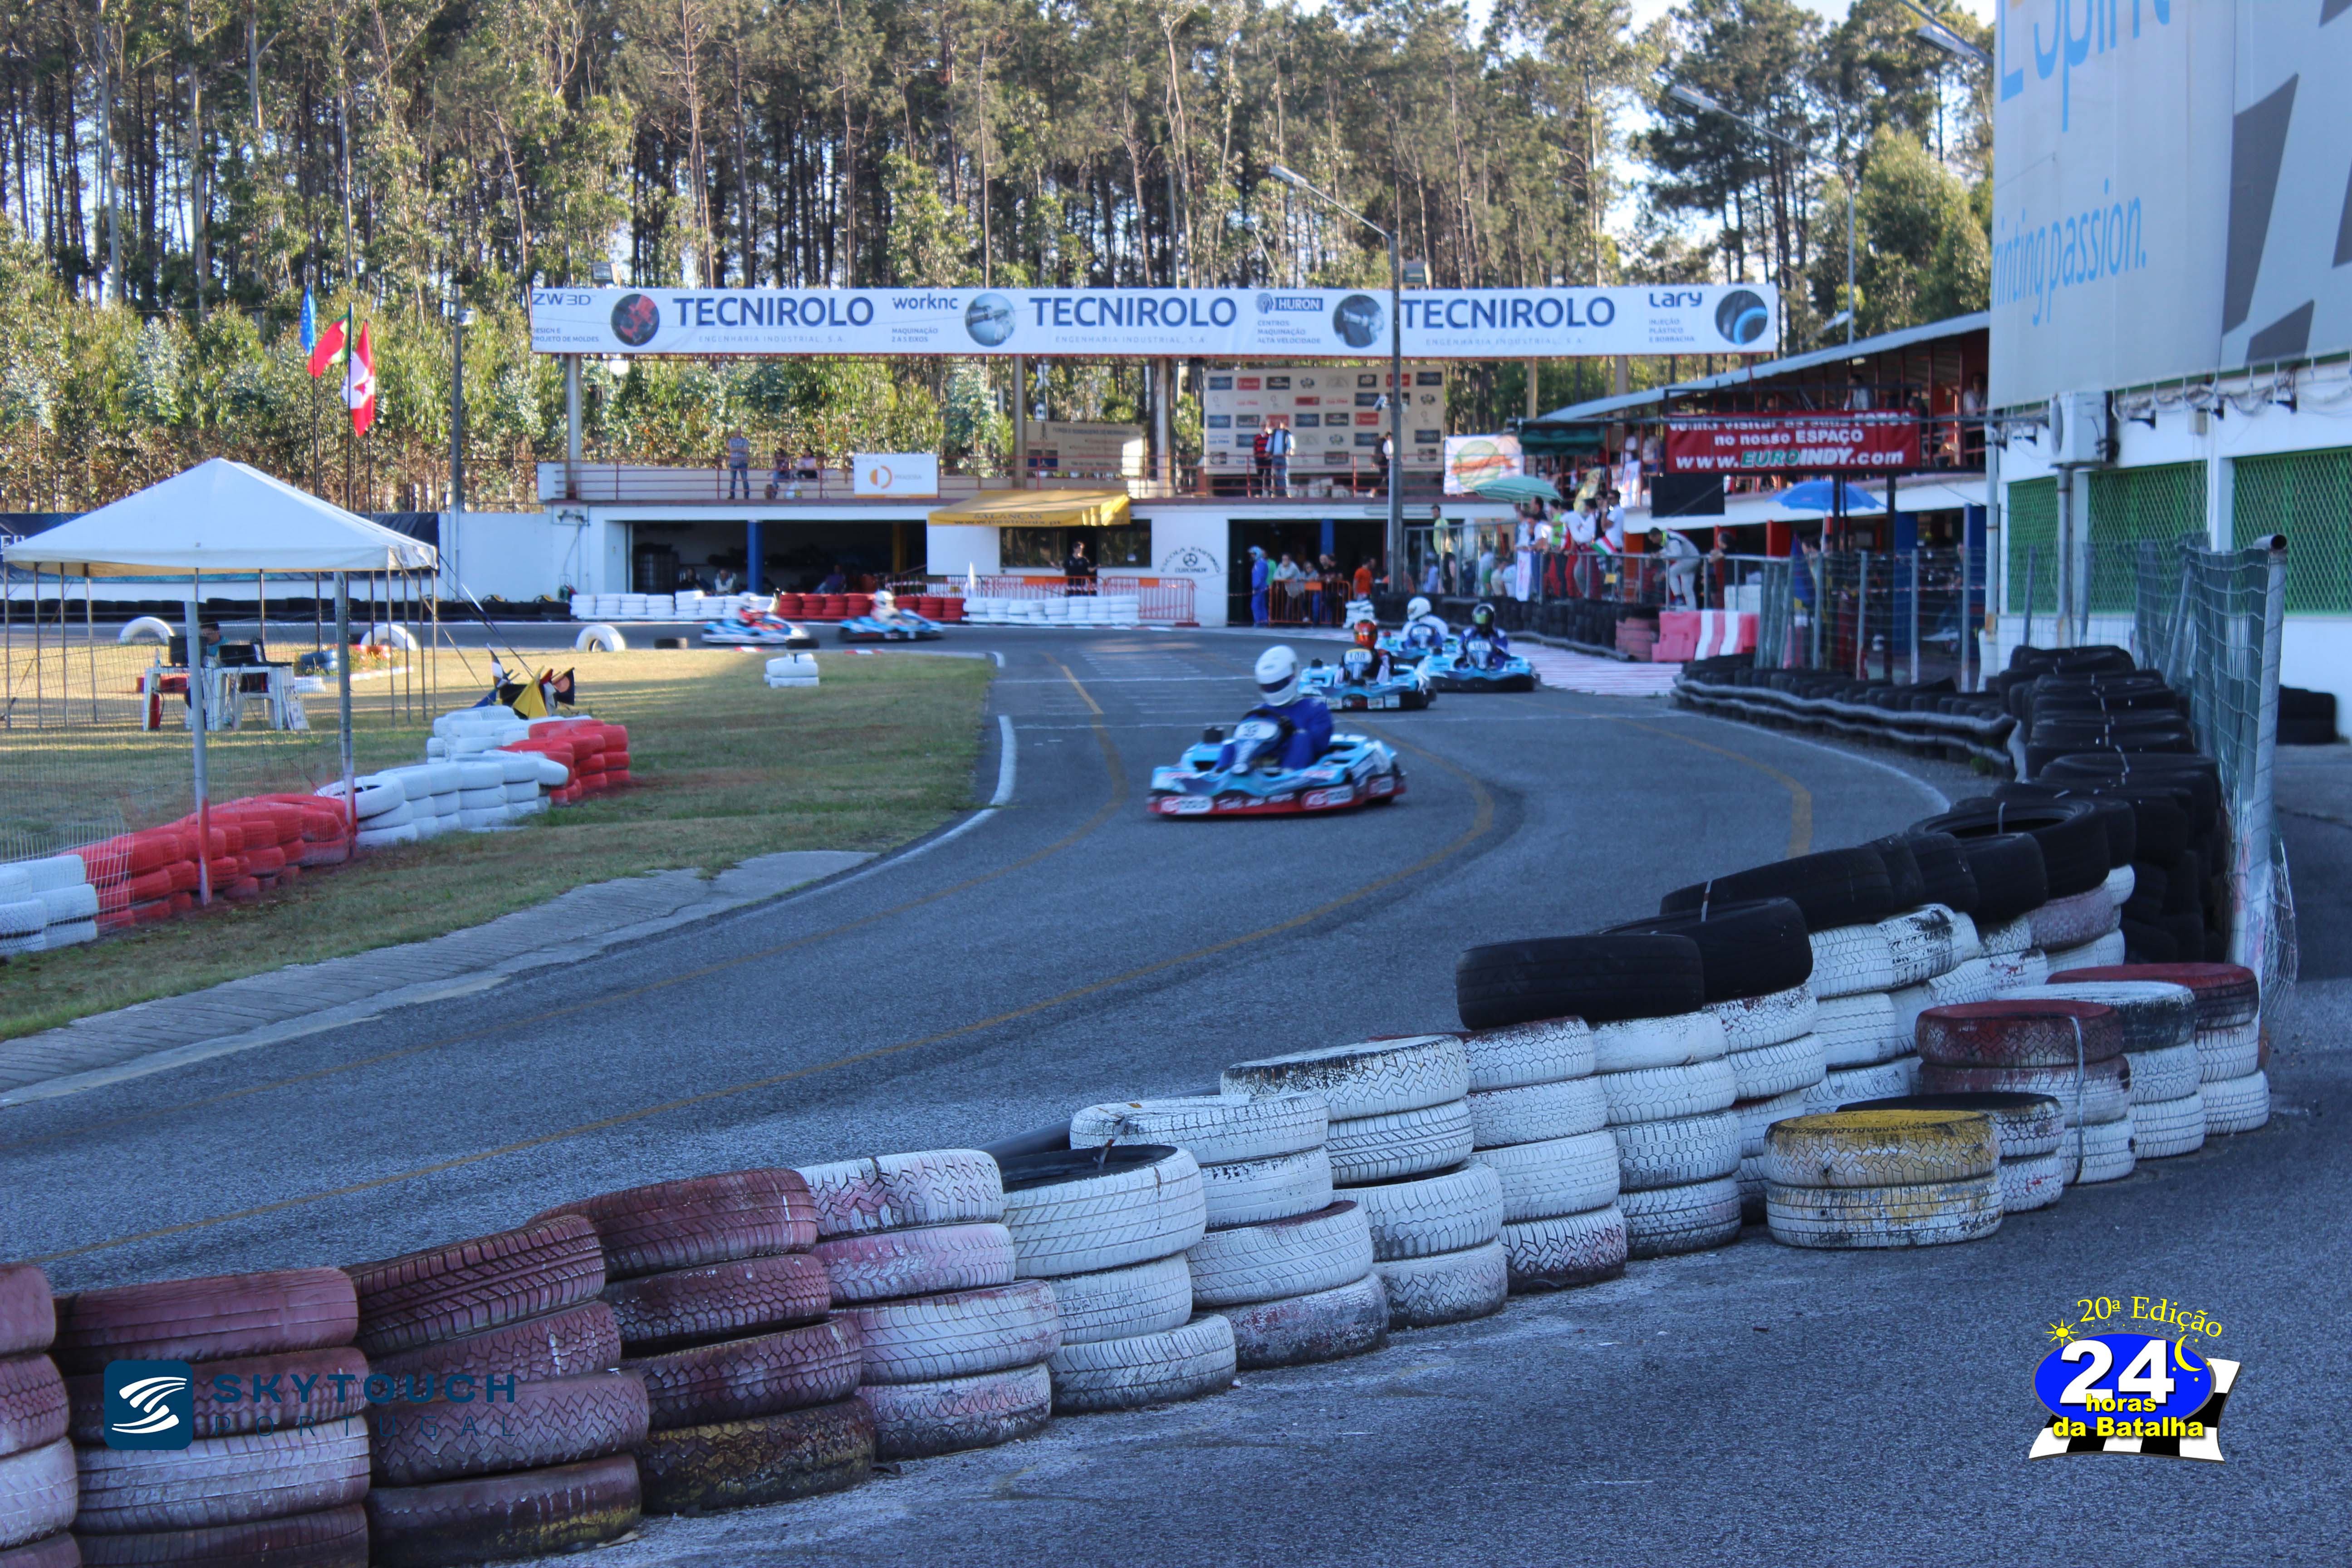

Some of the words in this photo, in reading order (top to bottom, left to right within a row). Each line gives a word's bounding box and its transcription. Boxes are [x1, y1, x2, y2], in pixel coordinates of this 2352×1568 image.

[1991, 207, 2045, 327] rinting
[2047, 177, 2146, 323] passion.
[532, 293, 592, 305] ZW3D
[892, 293, 959, 309] worknc
[1278, 299, 1319, 310] HURON
[672, 296, 874, 327] TECNIROLO
[1029, 296, 1236, 327] TECNIROLO
[1401, 297, 1615, 328] TECNIROLO
[1426, 338, 1491, 346] ENGENHARIA
[1714, 434, 1735, 446] no
[1740, 431, 1790, 446] nosso
[1795, 427, 1864, 446] ESPAÇO
[1675, 447, 1905, 470] www.EUROINDY.com
